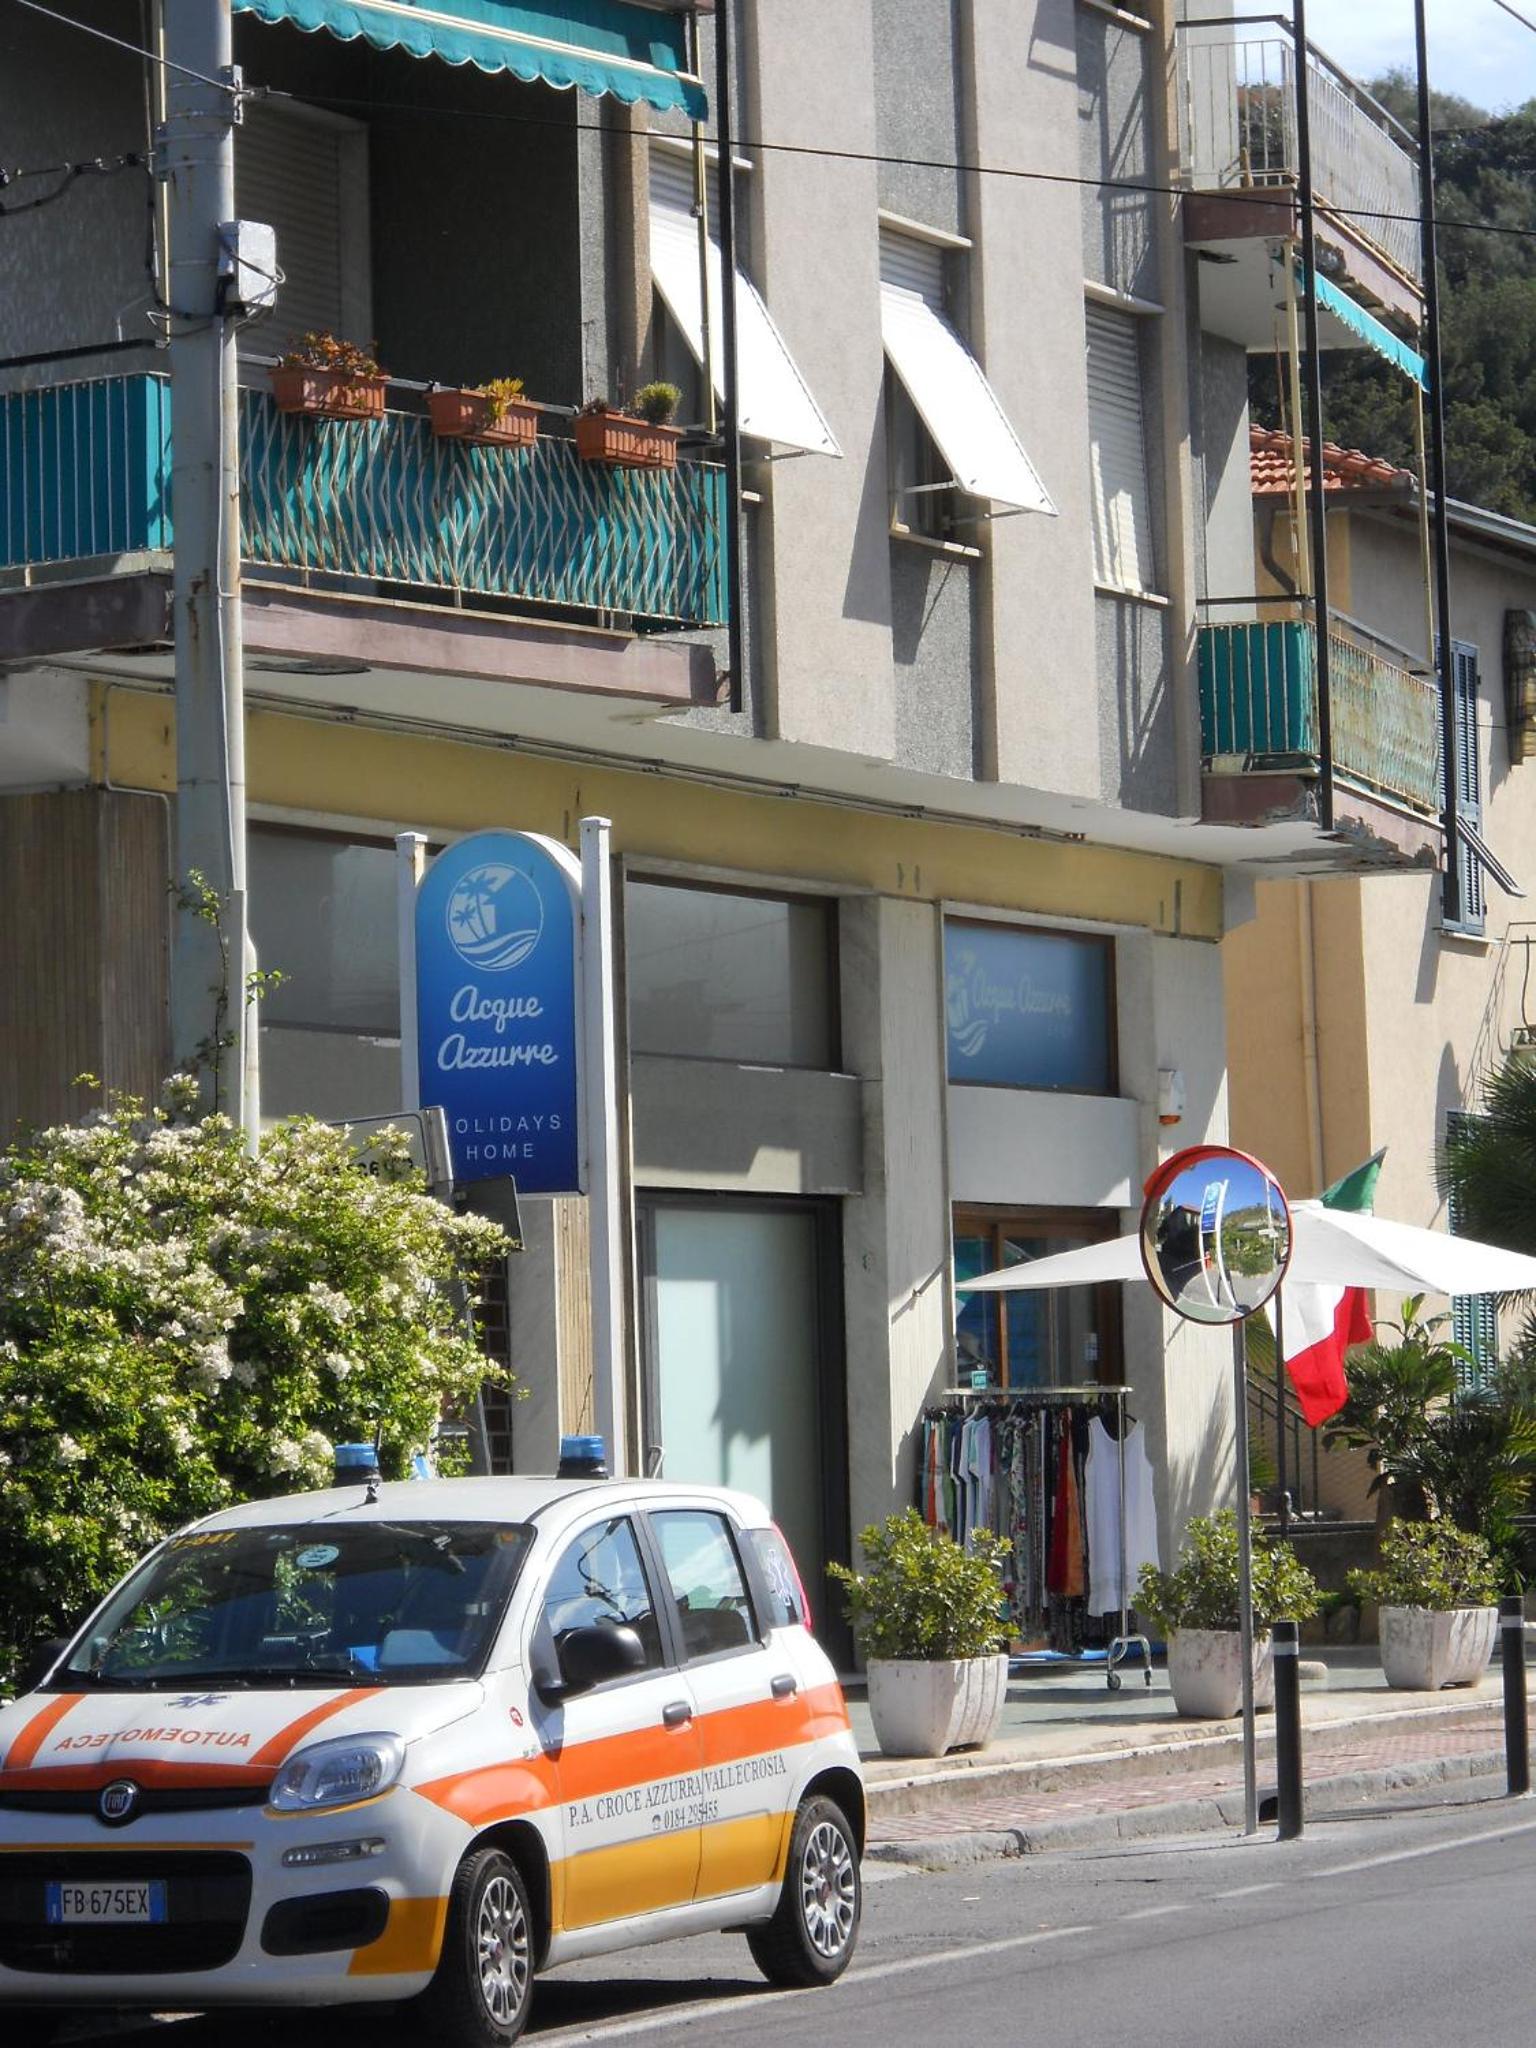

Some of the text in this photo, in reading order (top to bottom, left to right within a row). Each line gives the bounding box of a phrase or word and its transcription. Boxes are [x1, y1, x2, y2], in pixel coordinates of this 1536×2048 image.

[449, 984, 544, 1034] Acque
[437, 1033, 559, 1072] Azzurre
[455, 1114, 562, 1135] OLIDAYS
[465, 1142, 535, 1161] HOME
[568, 1754, 787, 1828] P.A. CROCE AZZURRA VALLECROSIA
[663, 1807, 686, 1830] 0184
[63, 1889, 148, 1915] FB 675EX
